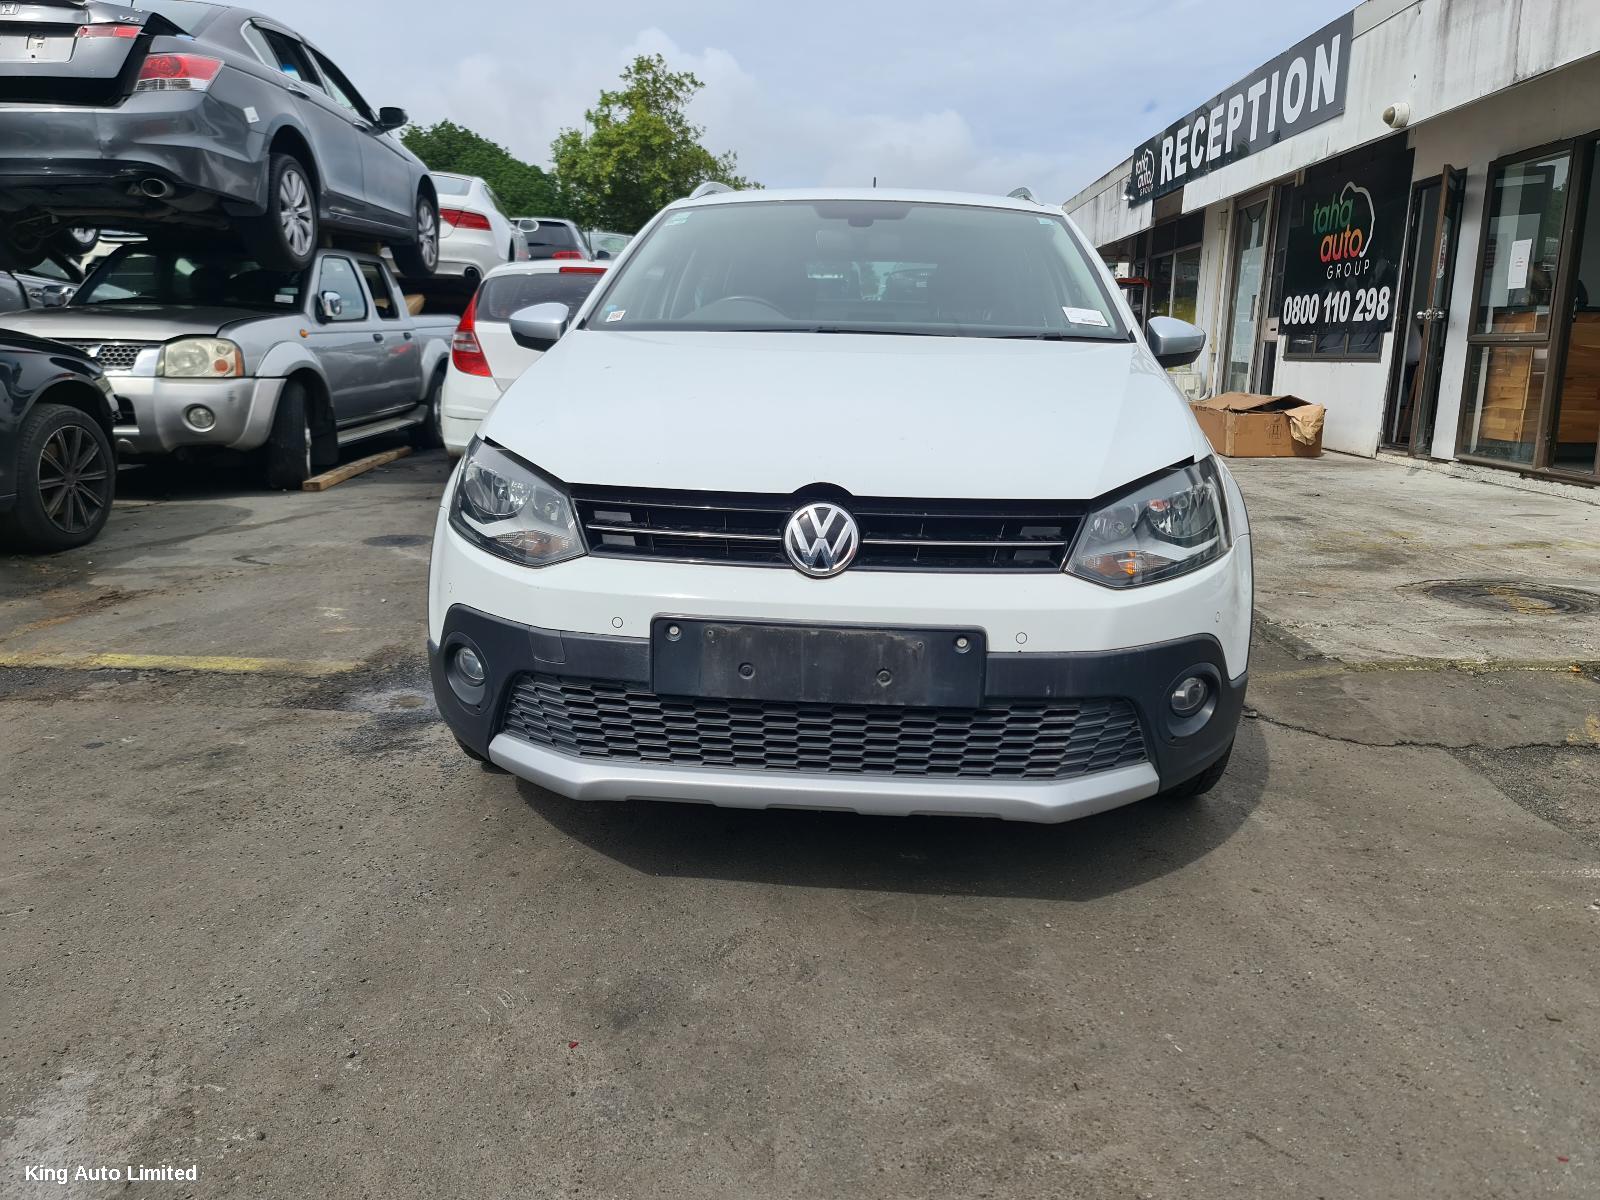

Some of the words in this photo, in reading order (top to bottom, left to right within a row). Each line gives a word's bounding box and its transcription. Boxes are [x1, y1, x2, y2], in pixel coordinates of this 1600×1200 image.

[1160, 33, 1341, 186] RECEPTION
[1137, 171, 1152, 188] auto
[1312, 194, 1354, 234] taha
[1320, 224, 1363, 263] auto
[1326, 259, 1370, 280] GROUP
[1283, 293, 1320, 325] 0800
[1323, 290, 1351, 323] 110
[1352, 286, 1391, 322] 298
